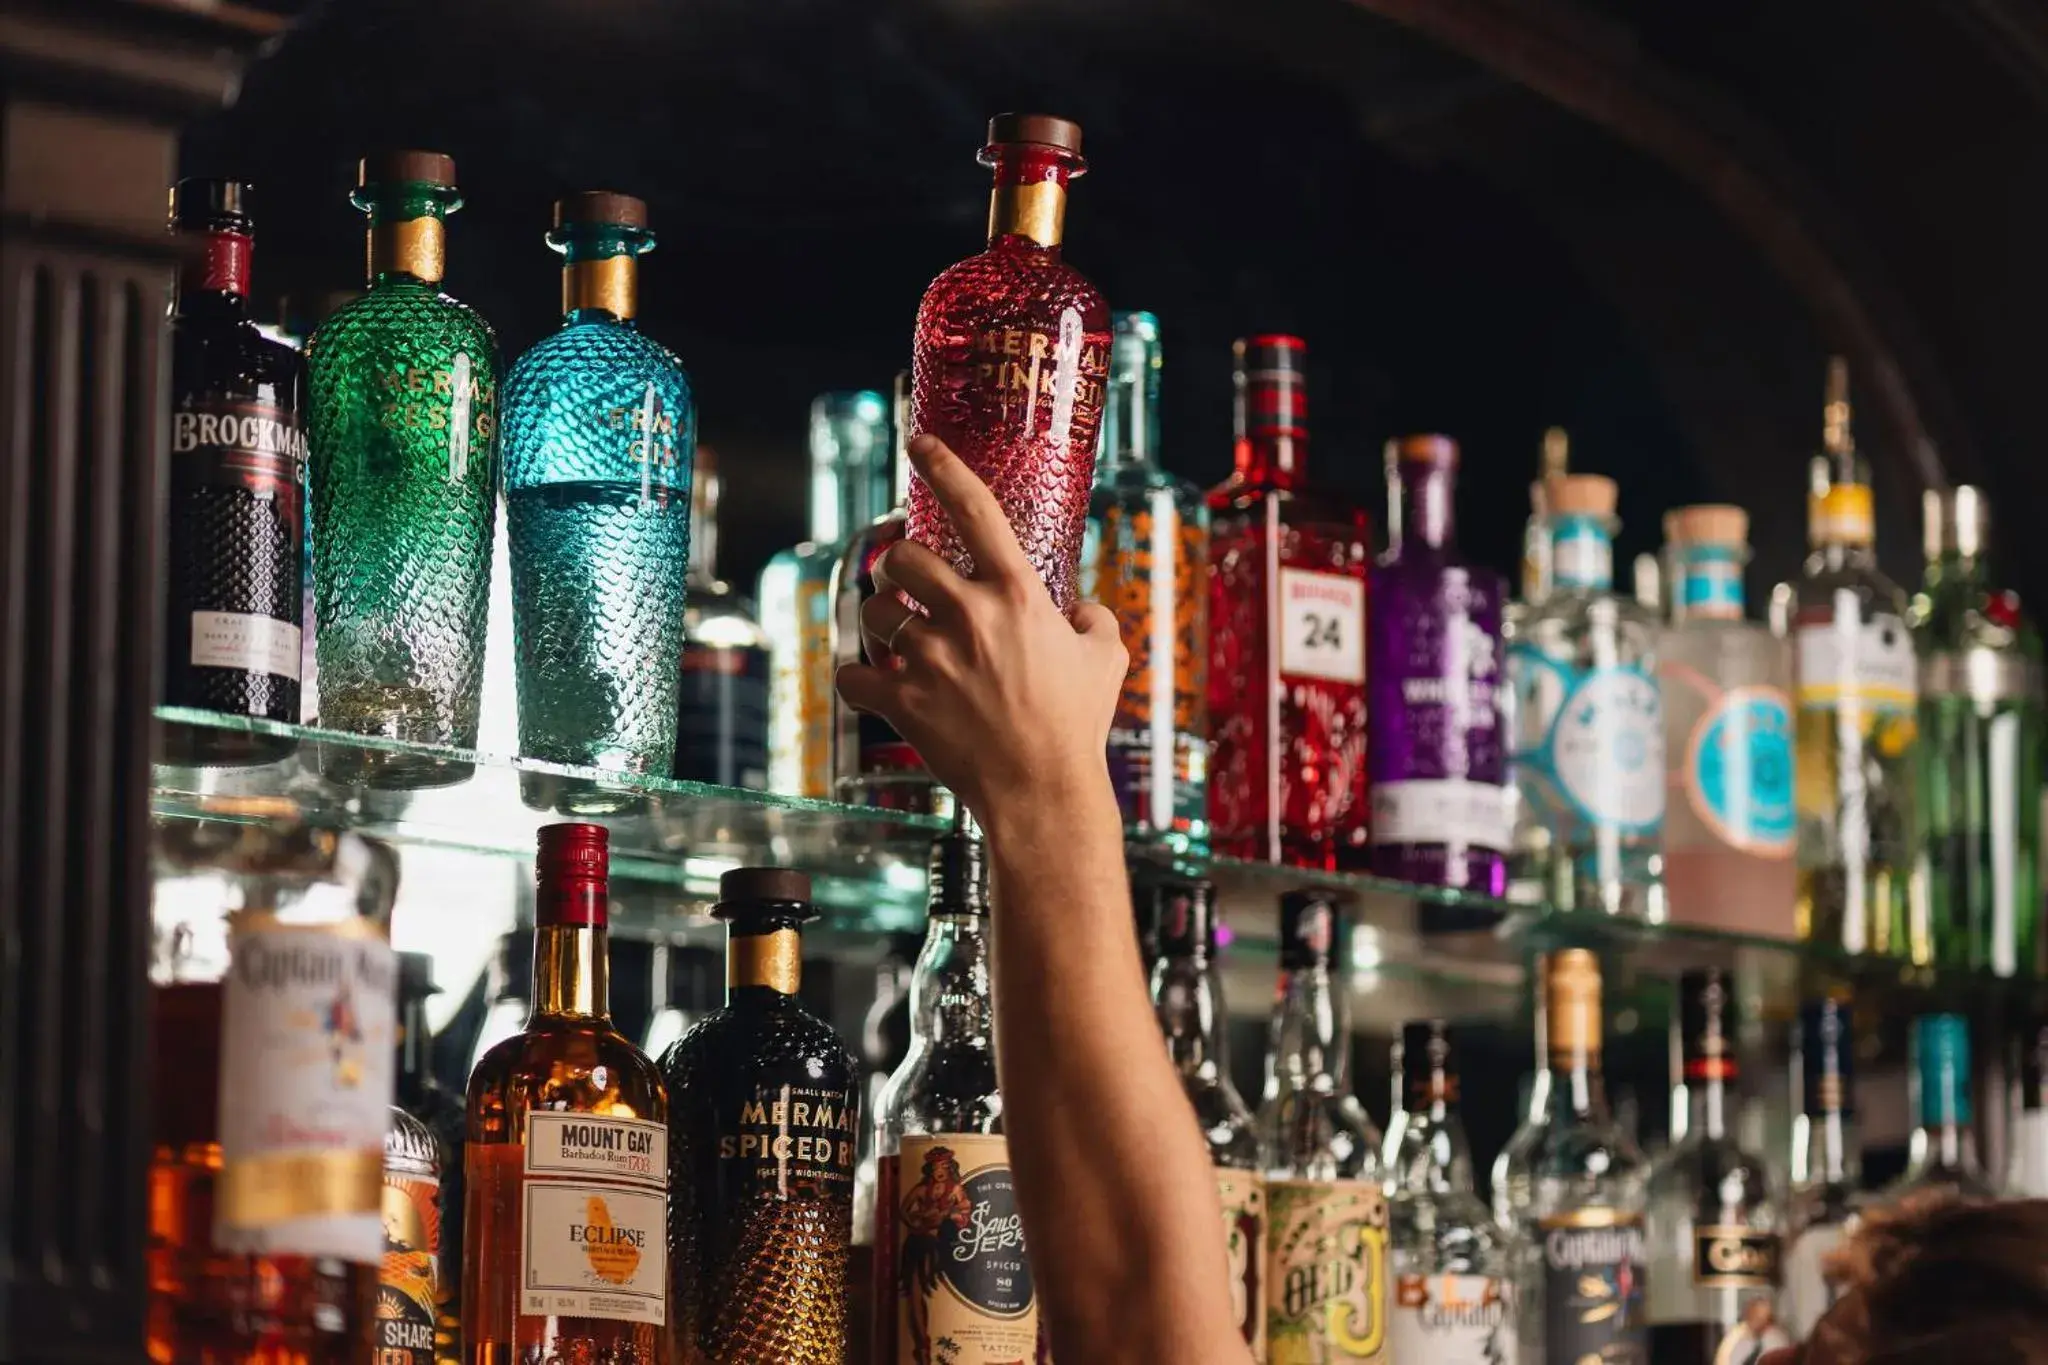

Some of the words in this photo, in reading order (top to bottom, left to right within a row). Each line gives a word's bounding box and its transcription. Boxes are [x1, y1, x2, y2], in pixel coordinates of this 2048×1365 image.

[1302, 612, 1342, 650] 24
[792, 1087, 819, 1097] SMALL
[561, 1124, 625, 1150] MOUNT
[628, 1131, 653, 1155] GAY
[720, 1134, 832, 1164] SPICED
[561, 1147, 606, 1161] Barbados
[607, 1152, 628, 1164] Rum
[569, 1224, 646, 1248] ECLIPSE
[986, 1260, 1021, 1271] SPICED
[996, 1278, 1012, 1287] 80
[385, 1321, 434, 1351] SHARE
